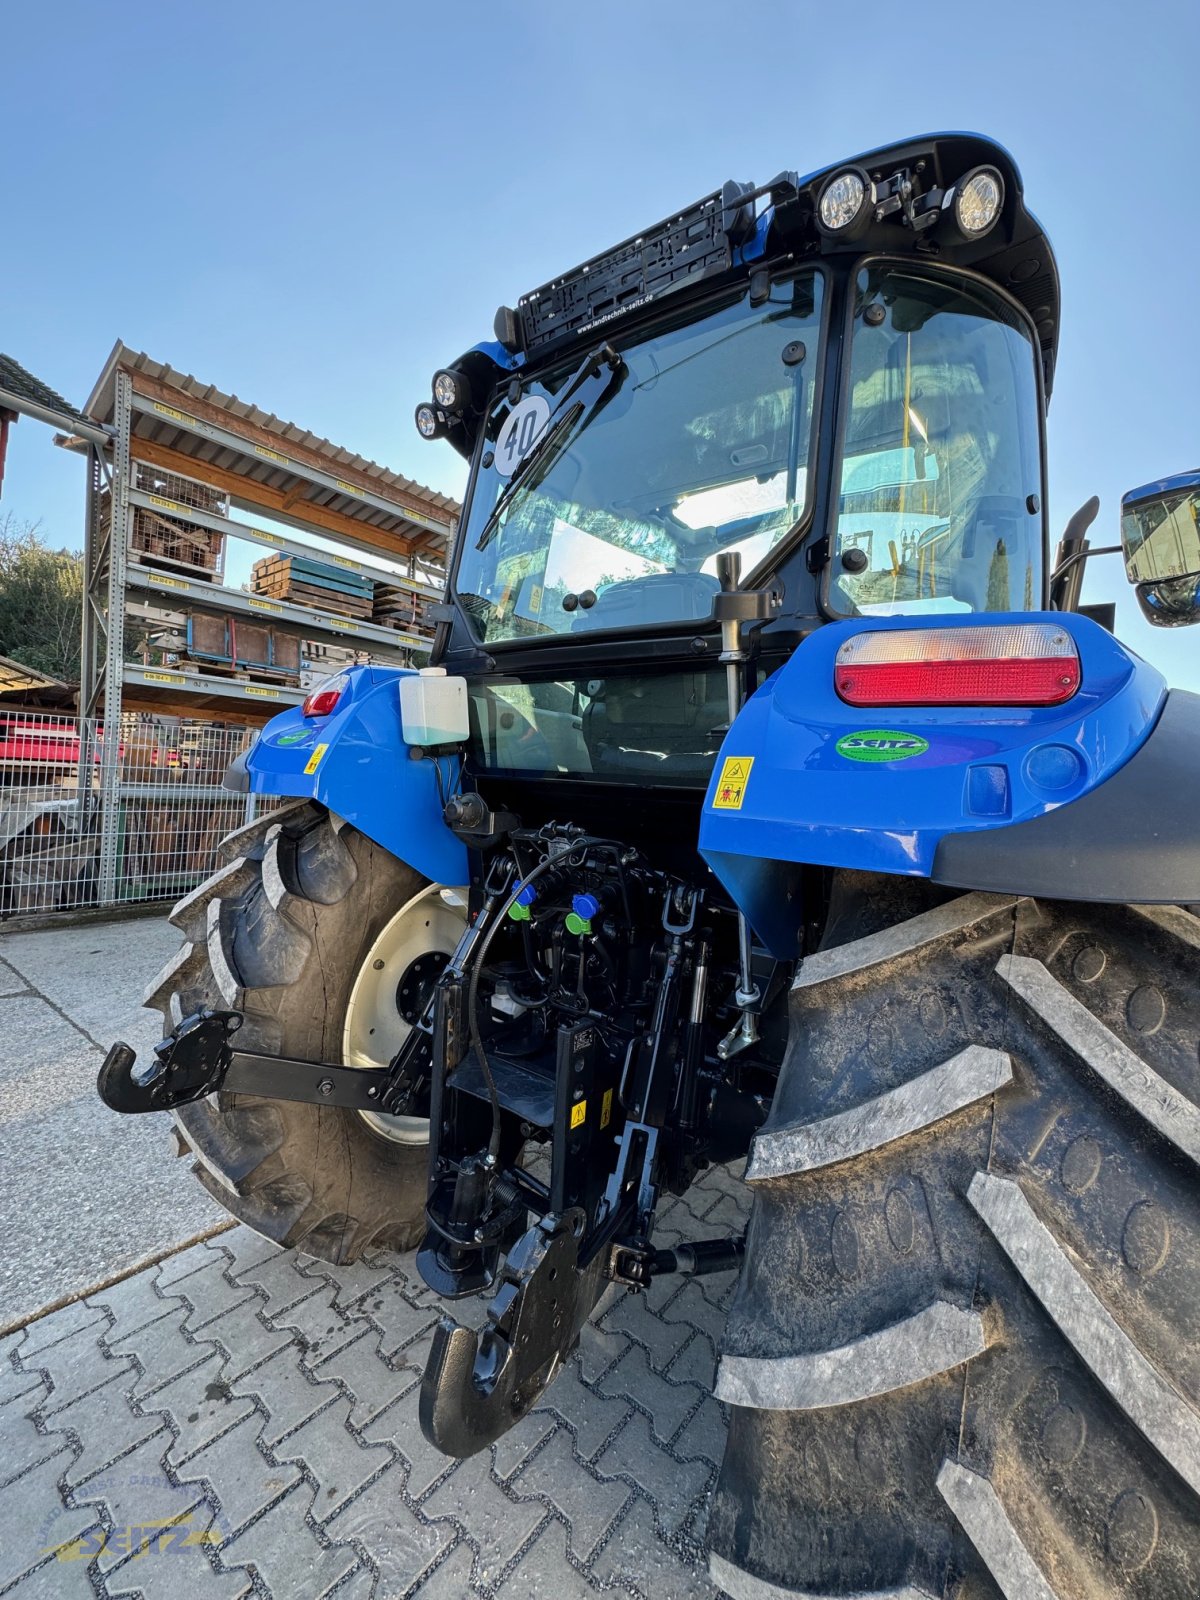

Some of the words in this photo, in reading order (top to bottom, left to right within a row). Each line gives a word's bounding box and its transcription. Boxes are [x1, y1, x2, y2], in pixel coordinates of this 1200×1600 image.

[577, 294, 654, 335] www.landtechnik-seitz.de
[504, 410, 538, 461] 40
[848, 738, 917, 749] SEITZ
